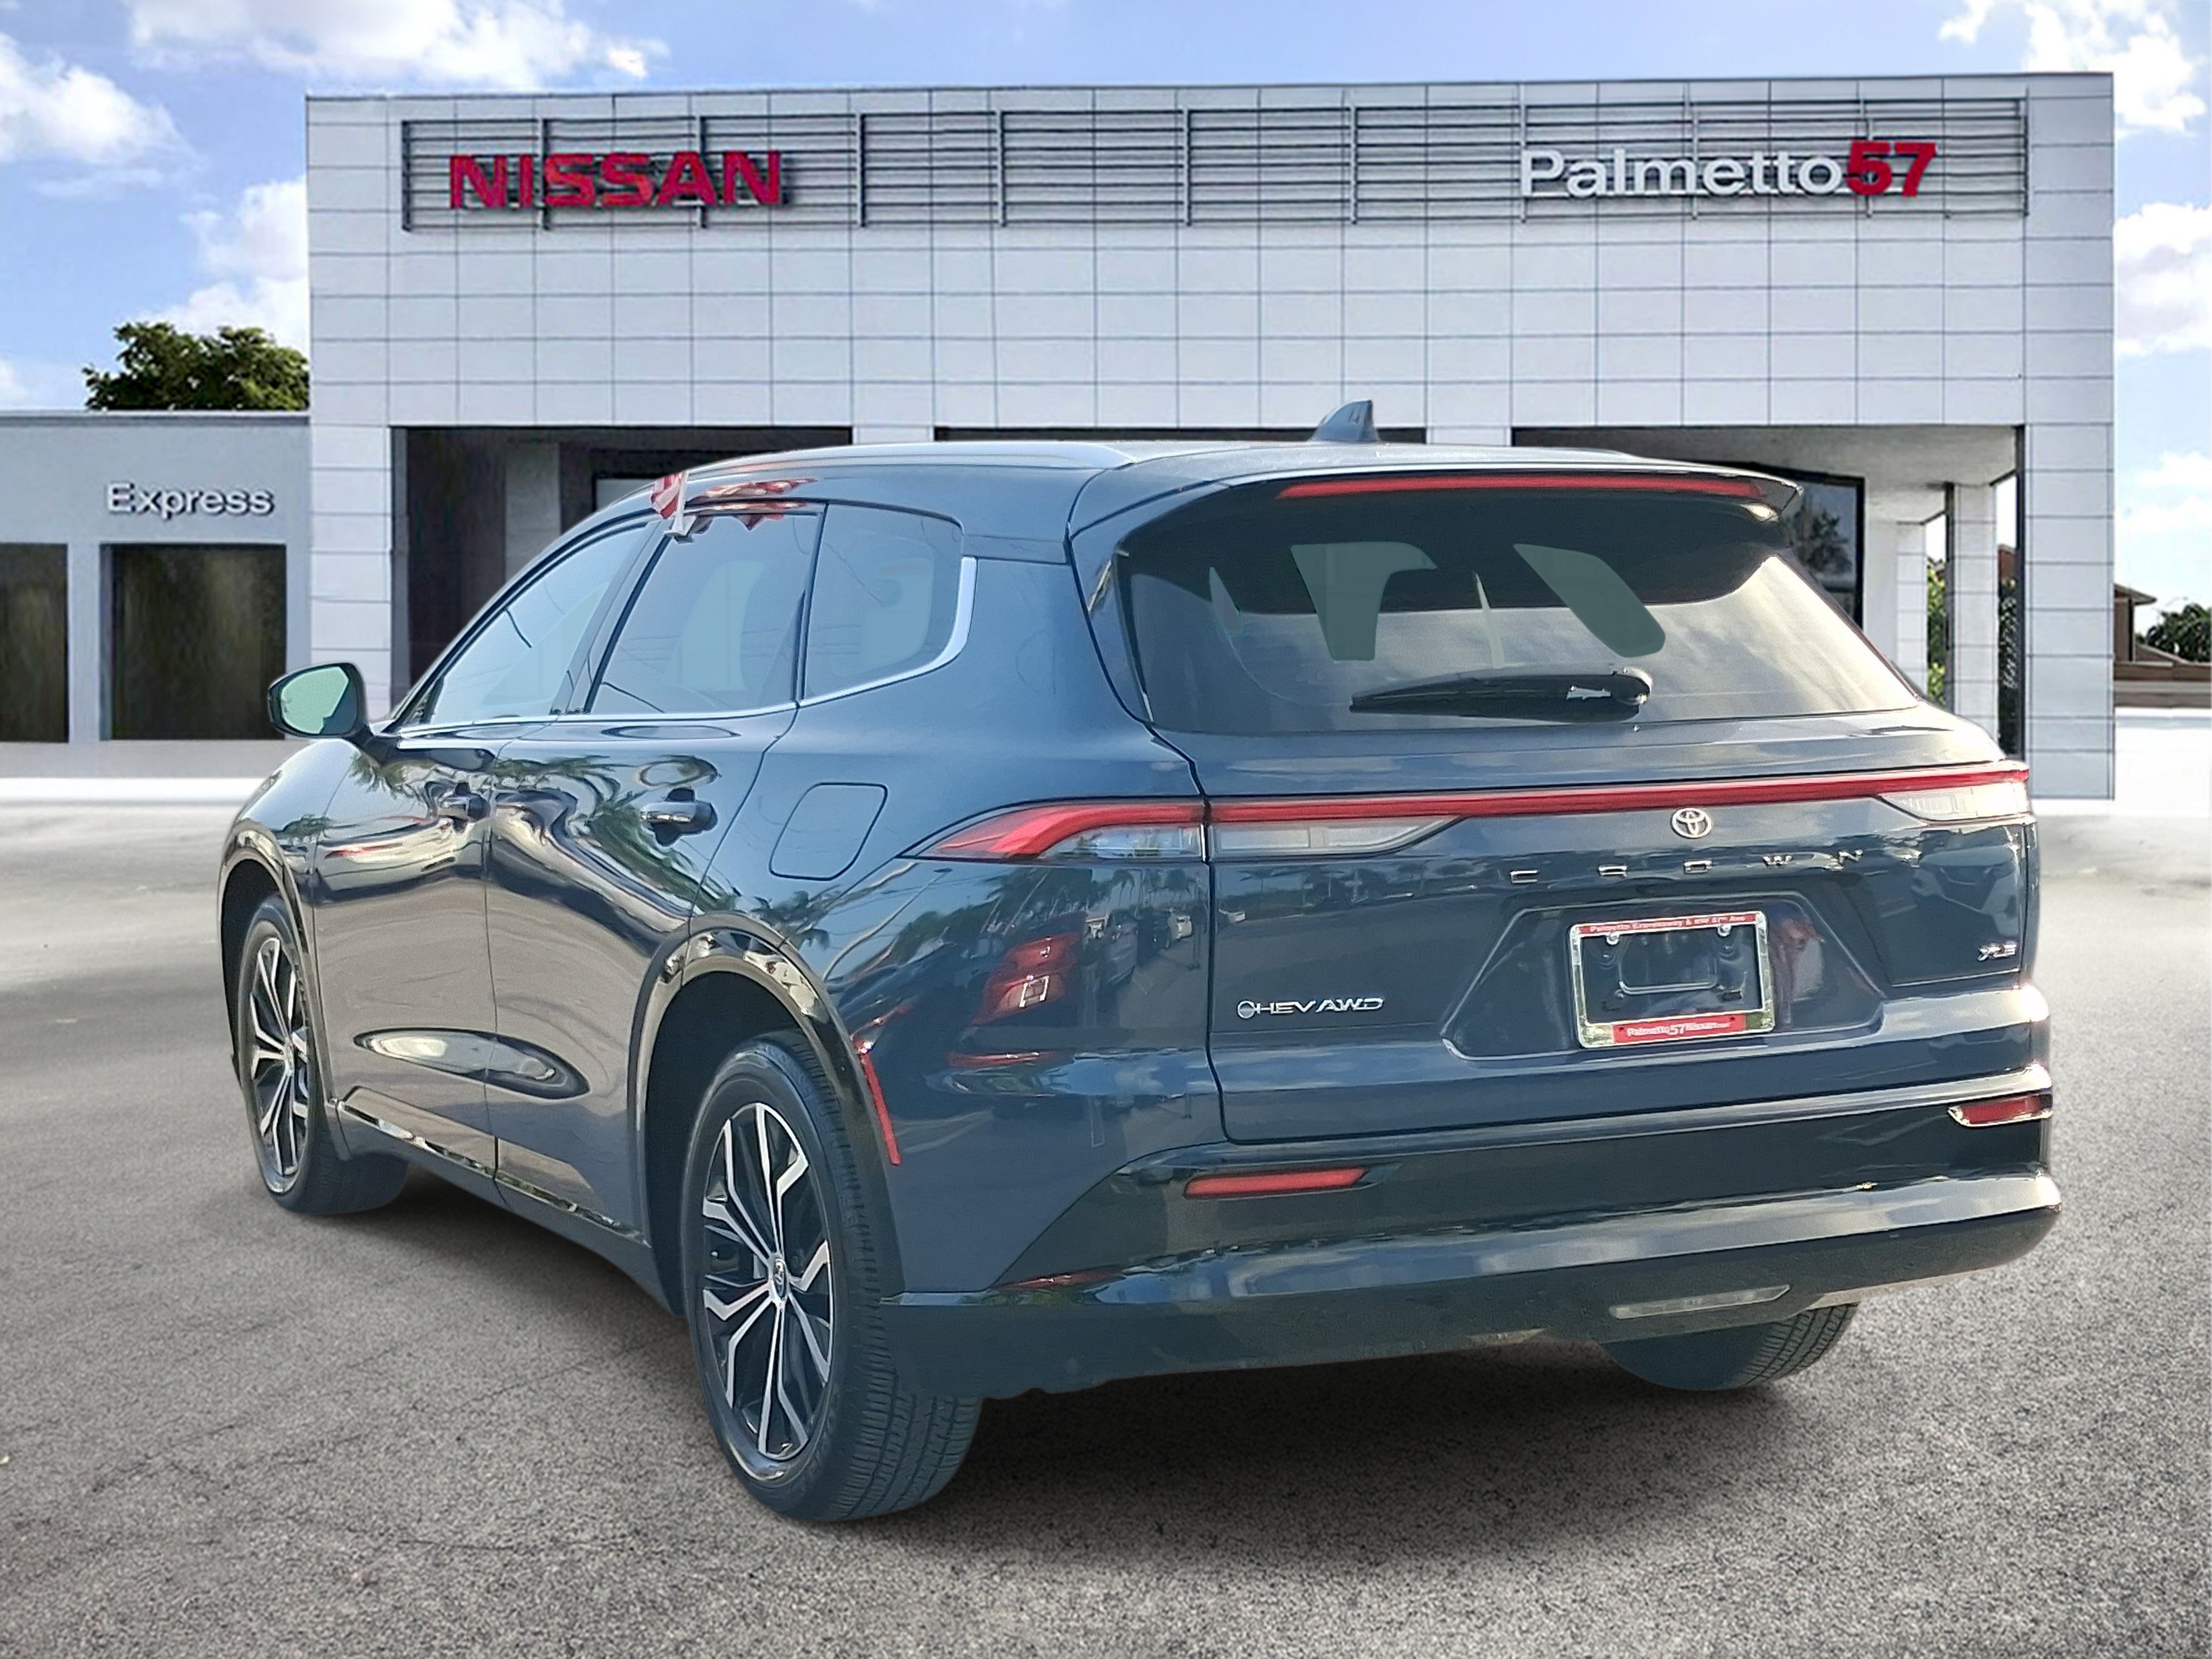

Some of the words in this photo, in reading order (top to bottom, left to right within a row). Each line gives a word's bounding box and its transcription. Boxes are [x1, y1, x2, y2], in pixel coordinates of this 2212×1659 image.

[449, 149, 781, 209] NISSAN
[1523, 140, 1937, 197] Palmetto57
[107, 482, 274, 520] Express
